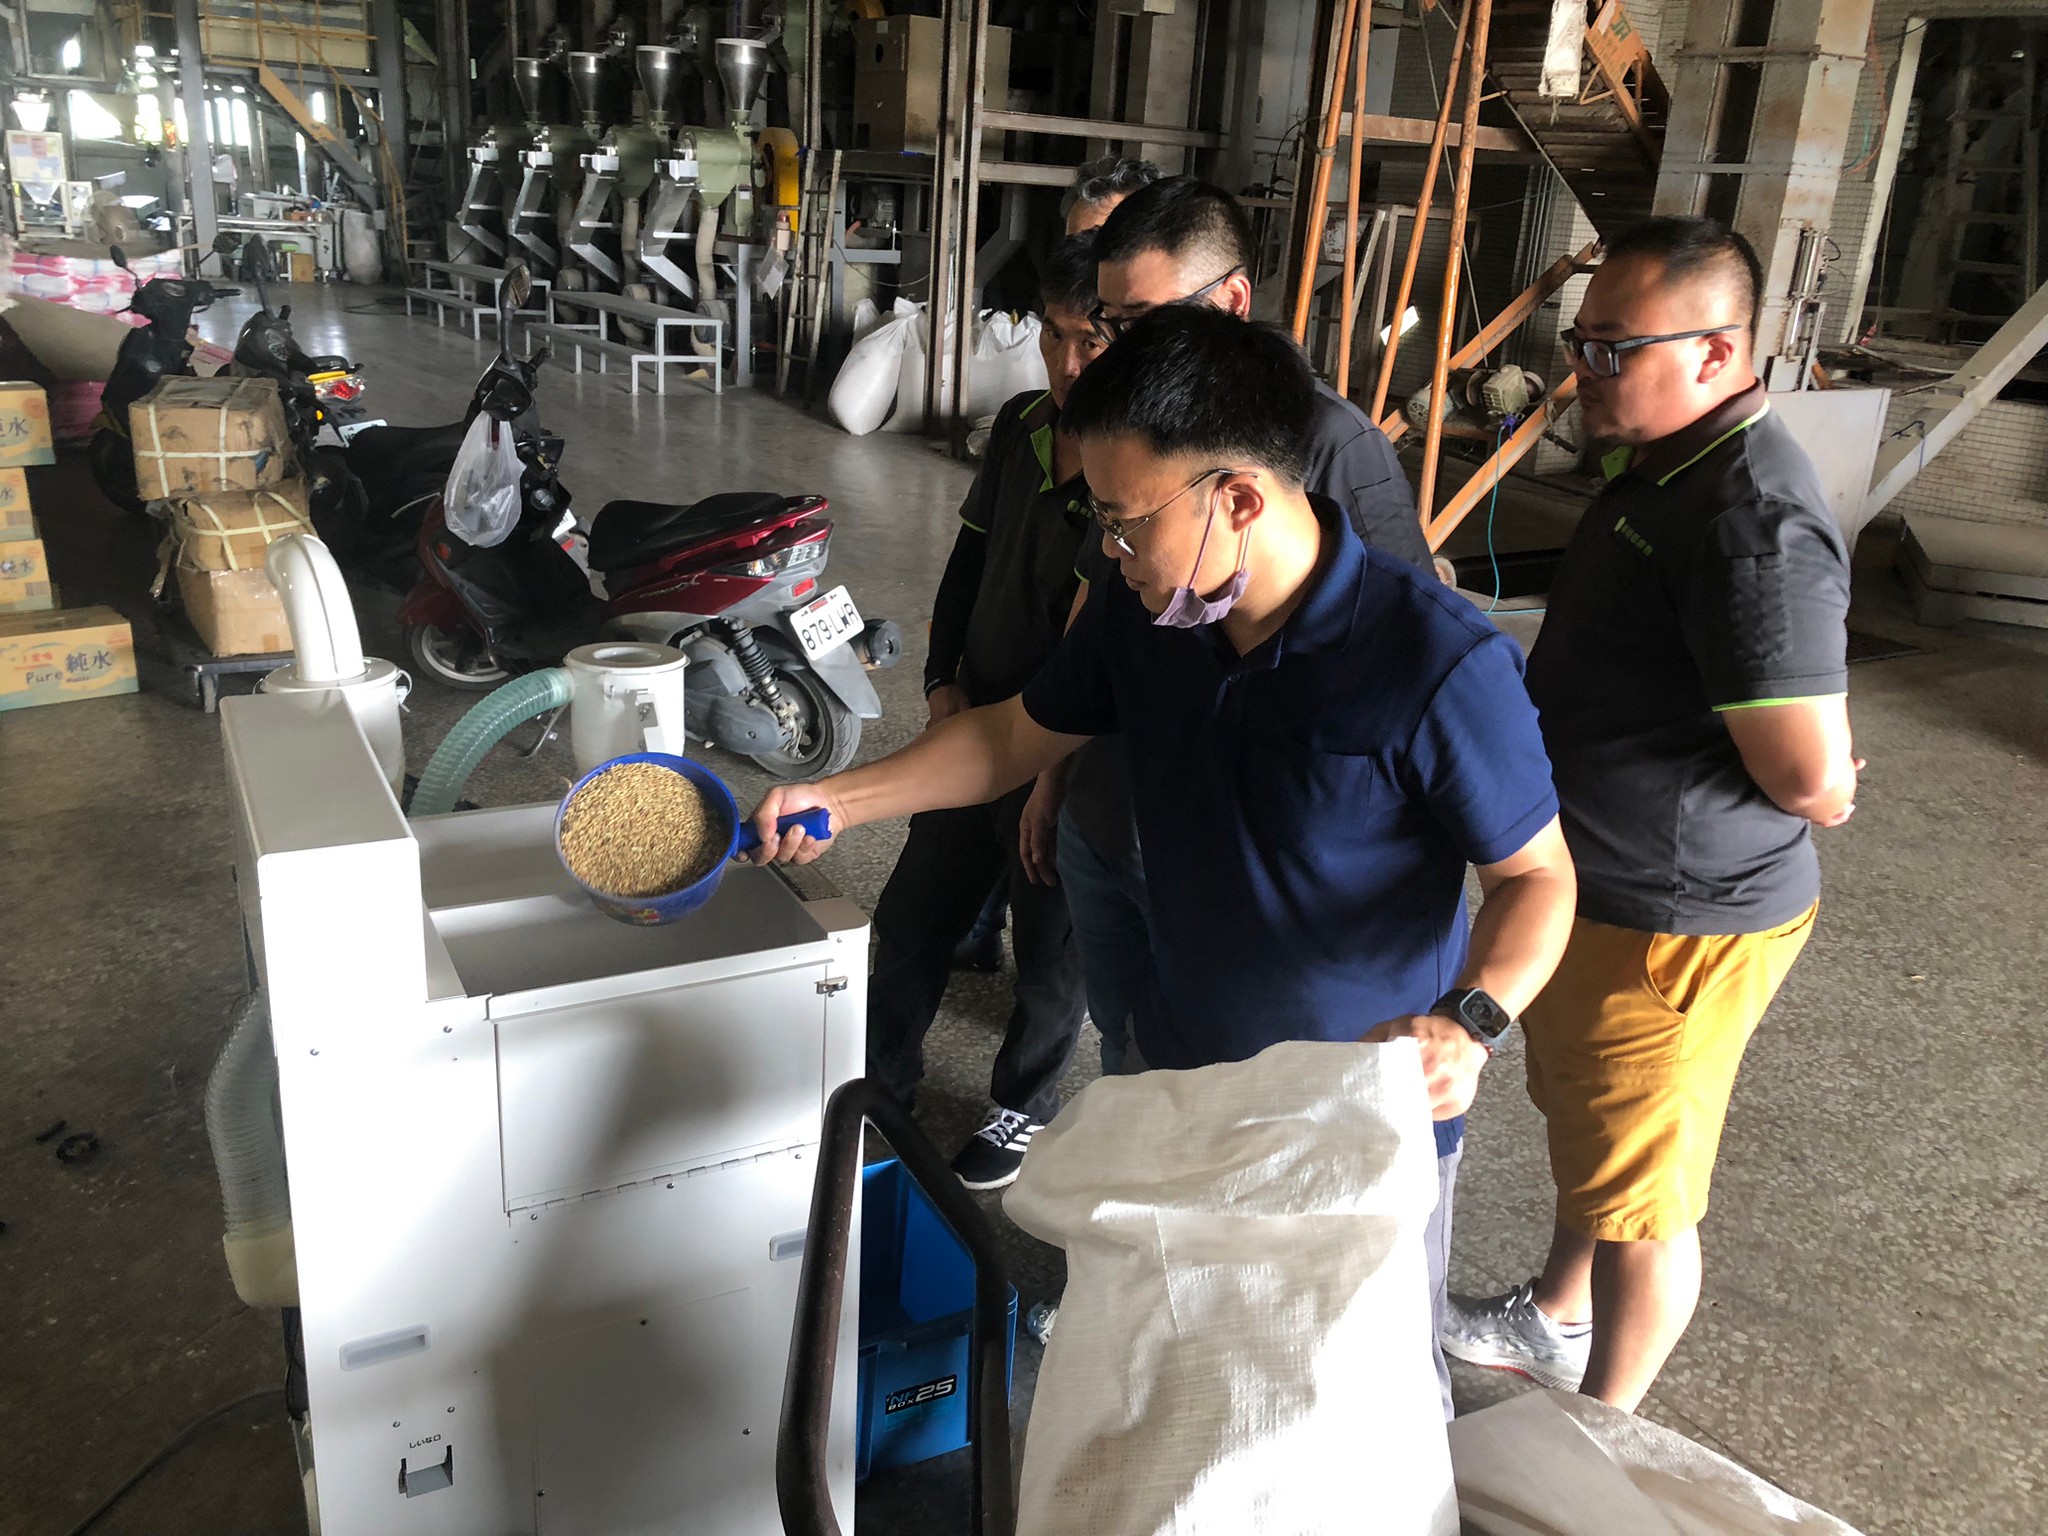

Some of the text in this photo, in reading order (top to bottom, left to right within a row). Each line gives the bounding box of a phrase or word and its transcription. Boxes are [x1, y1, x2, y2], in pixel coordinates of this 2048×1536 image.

[66, 650, 113, 673] 純水
[26, 671, 64, 685] Pure
[915, 1378, 955, 1402] 25
